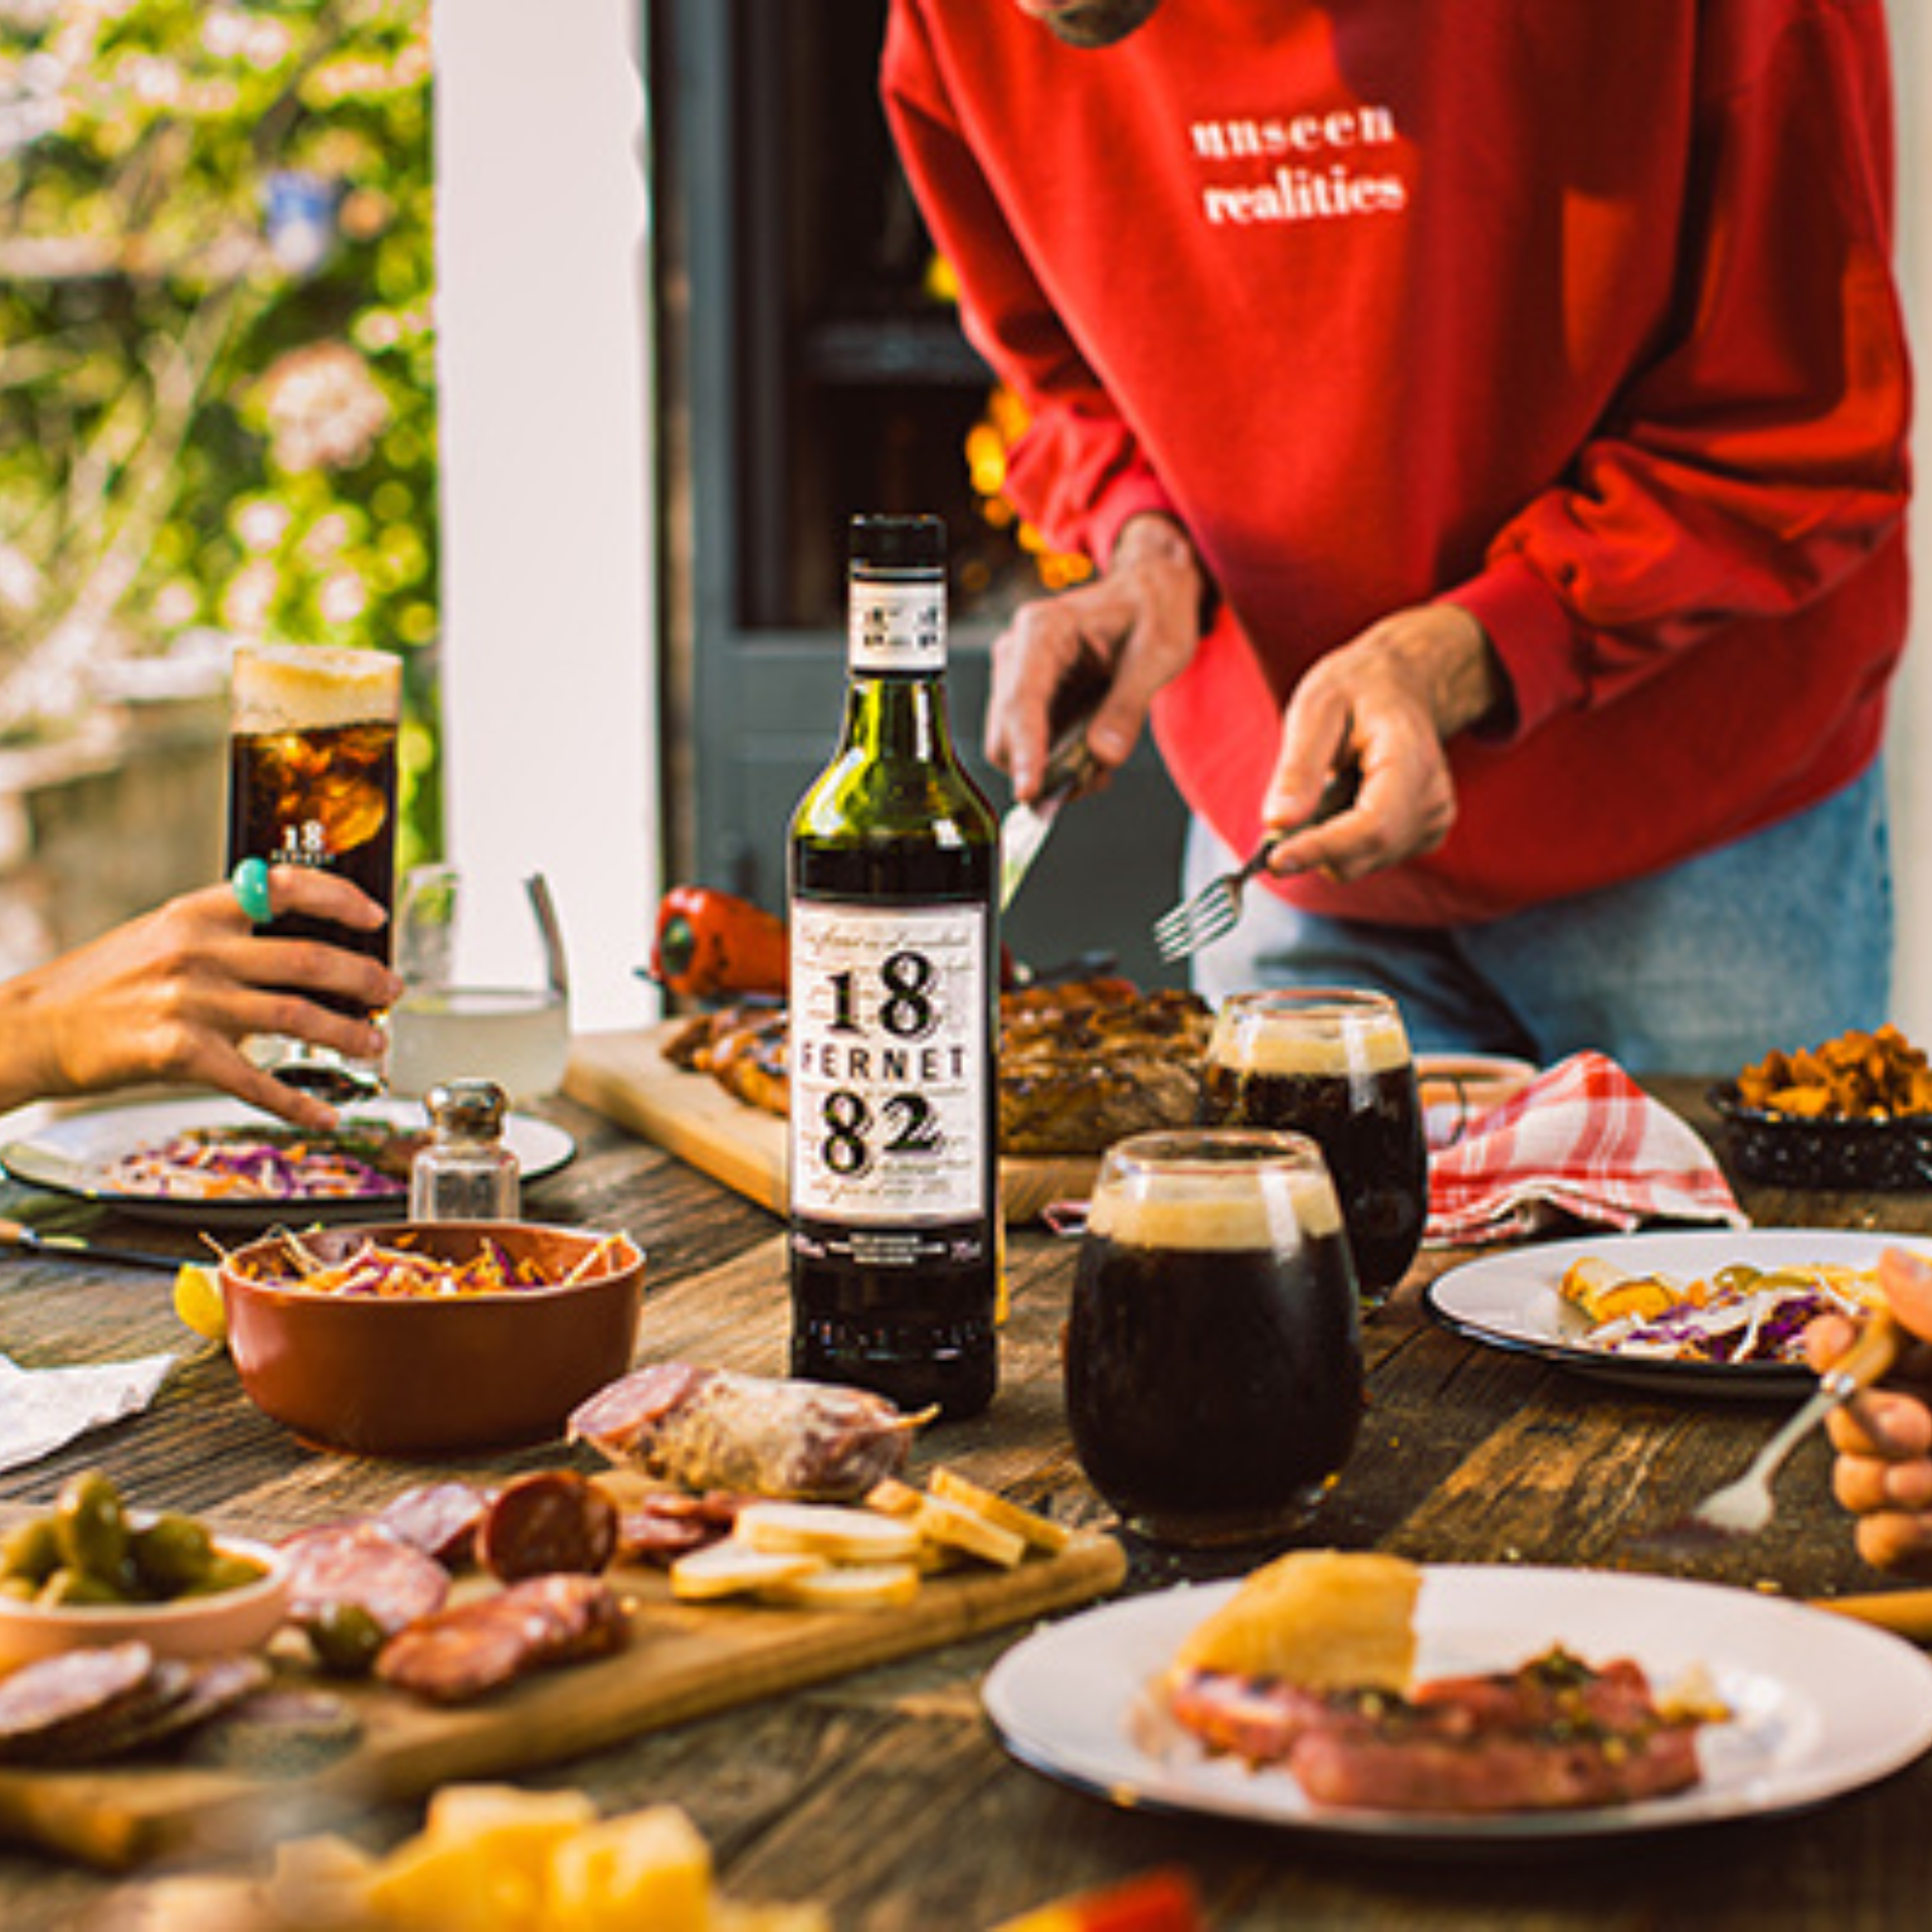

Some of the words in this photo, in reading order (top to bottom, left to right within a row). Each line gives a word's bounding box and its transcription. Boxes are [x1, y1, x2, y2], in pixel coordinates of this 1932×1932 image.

[1190, 106, 1396, 161] unseen
[1202, 165, 1407, 224] realities
[284, 819, 327, 852] 18
[825, 950, 940, 1040] 18
[801, 1043, 965, 1081] FERNET
[823, 1090, 943, 1178] 82
